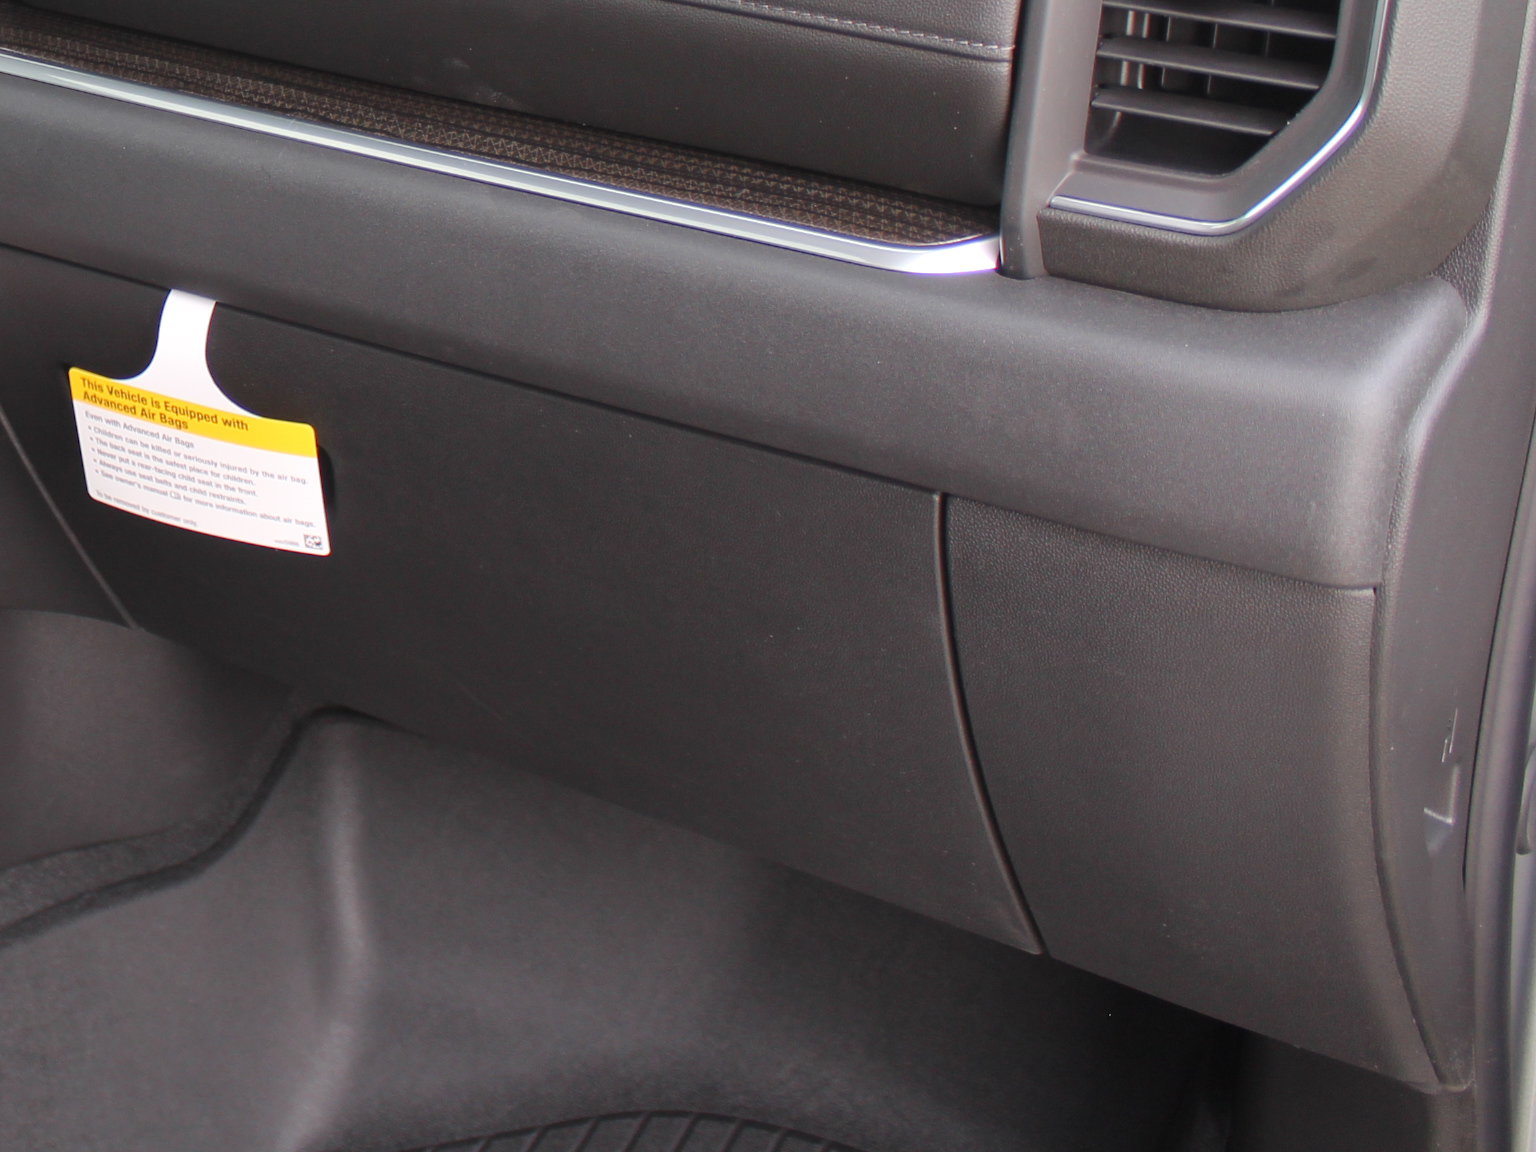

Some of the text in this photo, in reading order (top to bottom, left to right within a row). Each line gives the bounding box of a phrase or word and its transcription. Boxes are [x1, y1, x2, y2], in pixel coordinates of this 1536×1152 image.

[80, 377, 249, 431] This Vehicle is Equipped with
[83, 391, 189, 430] Advanced Air Bags
[85, 410, 194, 449] Even with Advanced Air Bags
[93, 426, 123, 441] Children
[125, 438, 138, 446] can
[139, 440, 149, 449] be
[151, 443, 171, 455] killed
[183, 453, 217, 468] seriously
[220, 461, 248, 473] injured
[250, 468, 259, 477] by
[262, 471, 275, 479] the
[95, 438, 108, 448] The
[152, 453, 163, 463] the
[165, 459, 187, 470] safest
[189, 465, 209, 476] place
[210, 470, 220, 479] for
[178, 471, 195, 482] child
[224, 484, 236, 492] the
[190, 486, 207, 497] child
[215, 504, 257, 518] information
[260, 512, 281, 522] about
